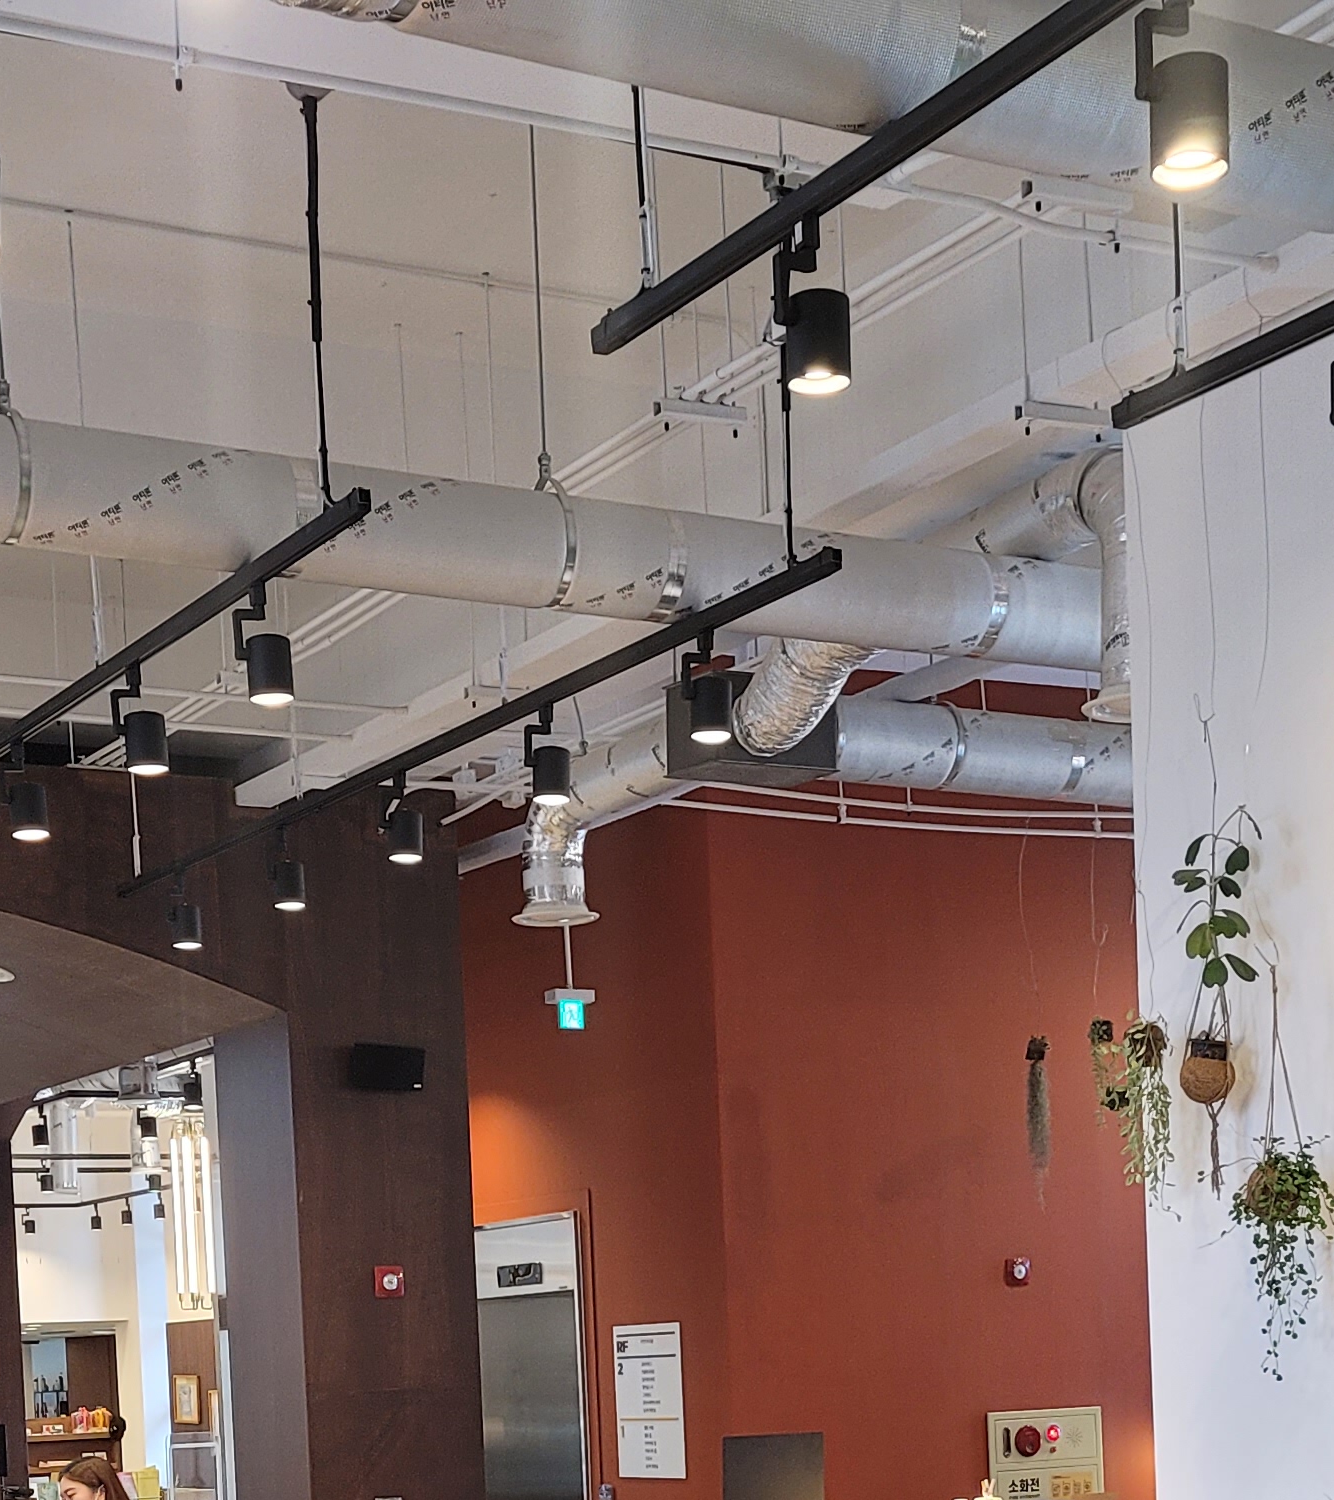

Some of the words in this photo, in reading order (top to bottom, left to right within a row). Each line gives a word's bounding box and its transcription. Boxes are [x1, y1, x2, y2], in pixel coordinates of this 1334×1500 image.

[1285, 88, 1306, 109] 아티론
[1248, 109, 1273, 132] 아티론
[161, 470, 181, 487] 아티론
[132, 485, 153, 503] 아티론
[101, 502, 124, 519] 아티론
[616, 1340, 629, 1354] RF
[617, 1363, 624, 1376] 2
[620, 1425, 625, 1438] 1
[1008, 1478, 1041, 1493] 소화전
